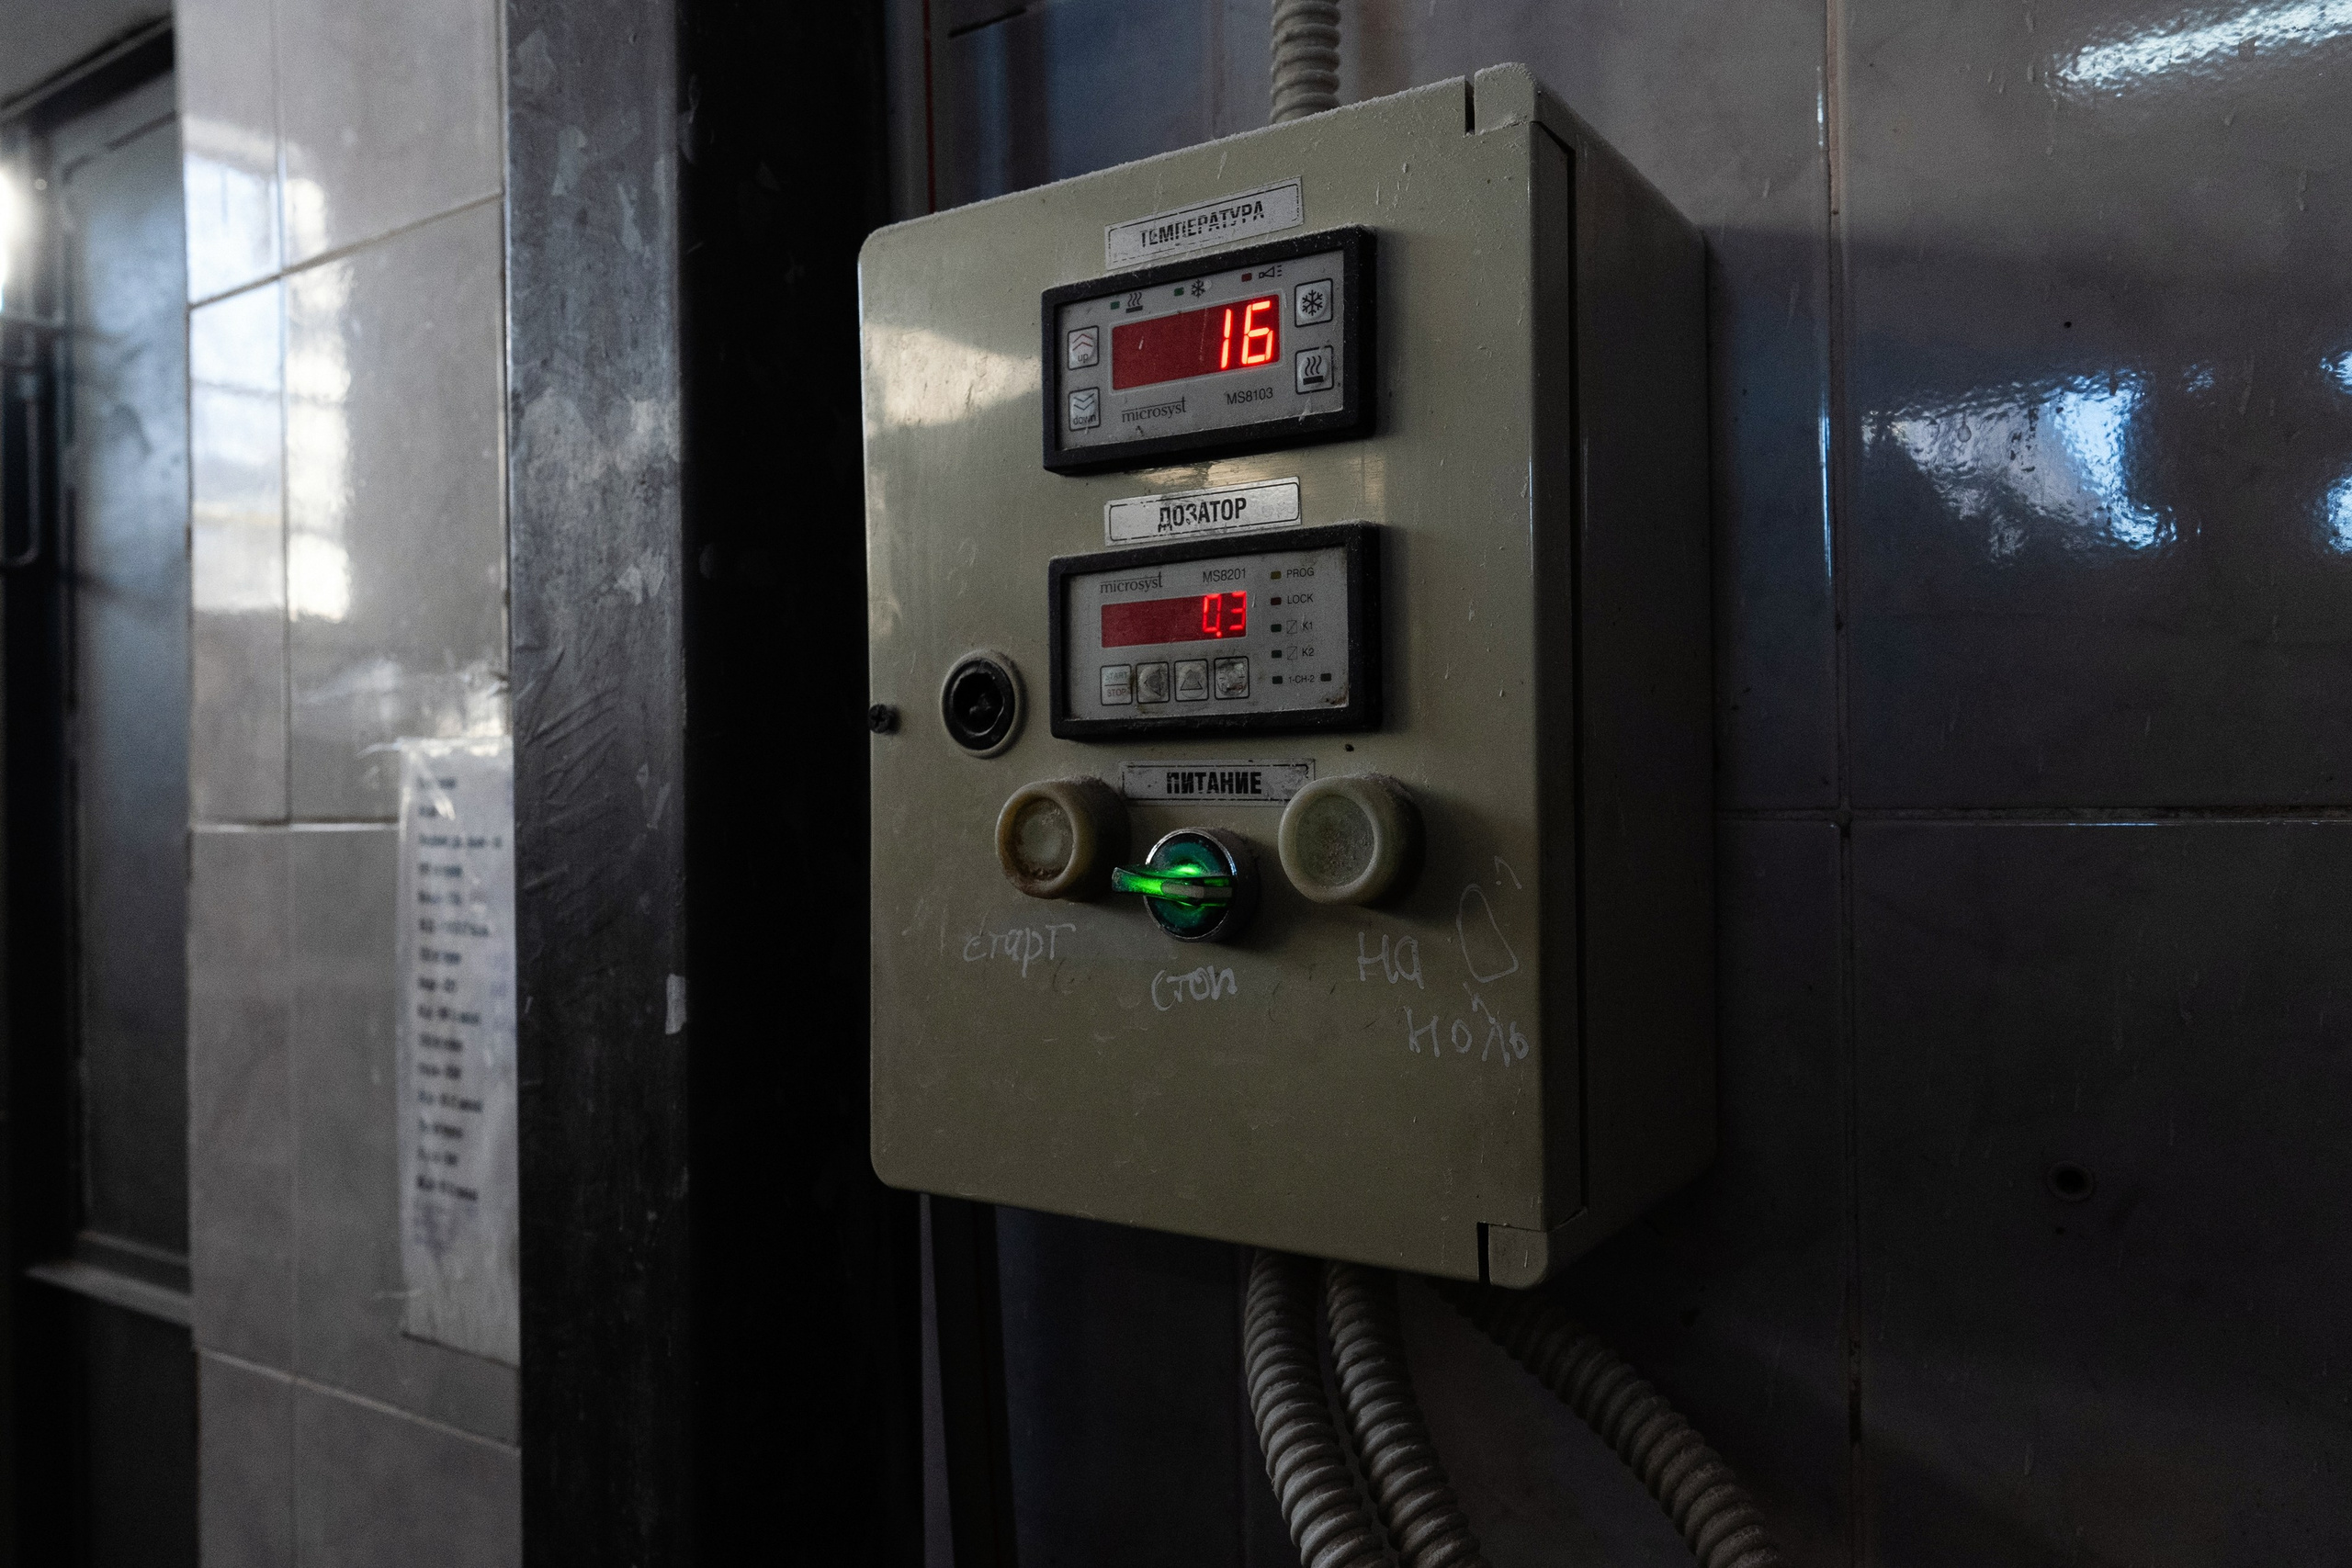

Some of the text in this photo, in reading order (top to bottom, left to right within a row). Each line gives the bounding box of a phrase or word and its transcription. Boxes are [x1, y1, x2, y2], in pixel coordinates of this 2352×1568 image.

[1140, 200, 1264, 248] ТЕМПЕРАТУРА
[1220, 299, 1274, 370] 16
[1227, 387, 1273, 406] MS8103
[1121, 396, 1187, 423] microsyst
[1158, 497, 1248, 533] ДОЗАТОР
[1100, 571, 1163, 594] microsyst
[1203, 568, 1247, 583] MS8201
[1286, 567, 1315, 579] PROG
[1287, 593, 1314, 605] LOCK
[1303, 622, 1314, 631] K1
[1302, 648, 1315, 657] K2
[1166, 771, 1262, 795] ПИТАНИЕ
